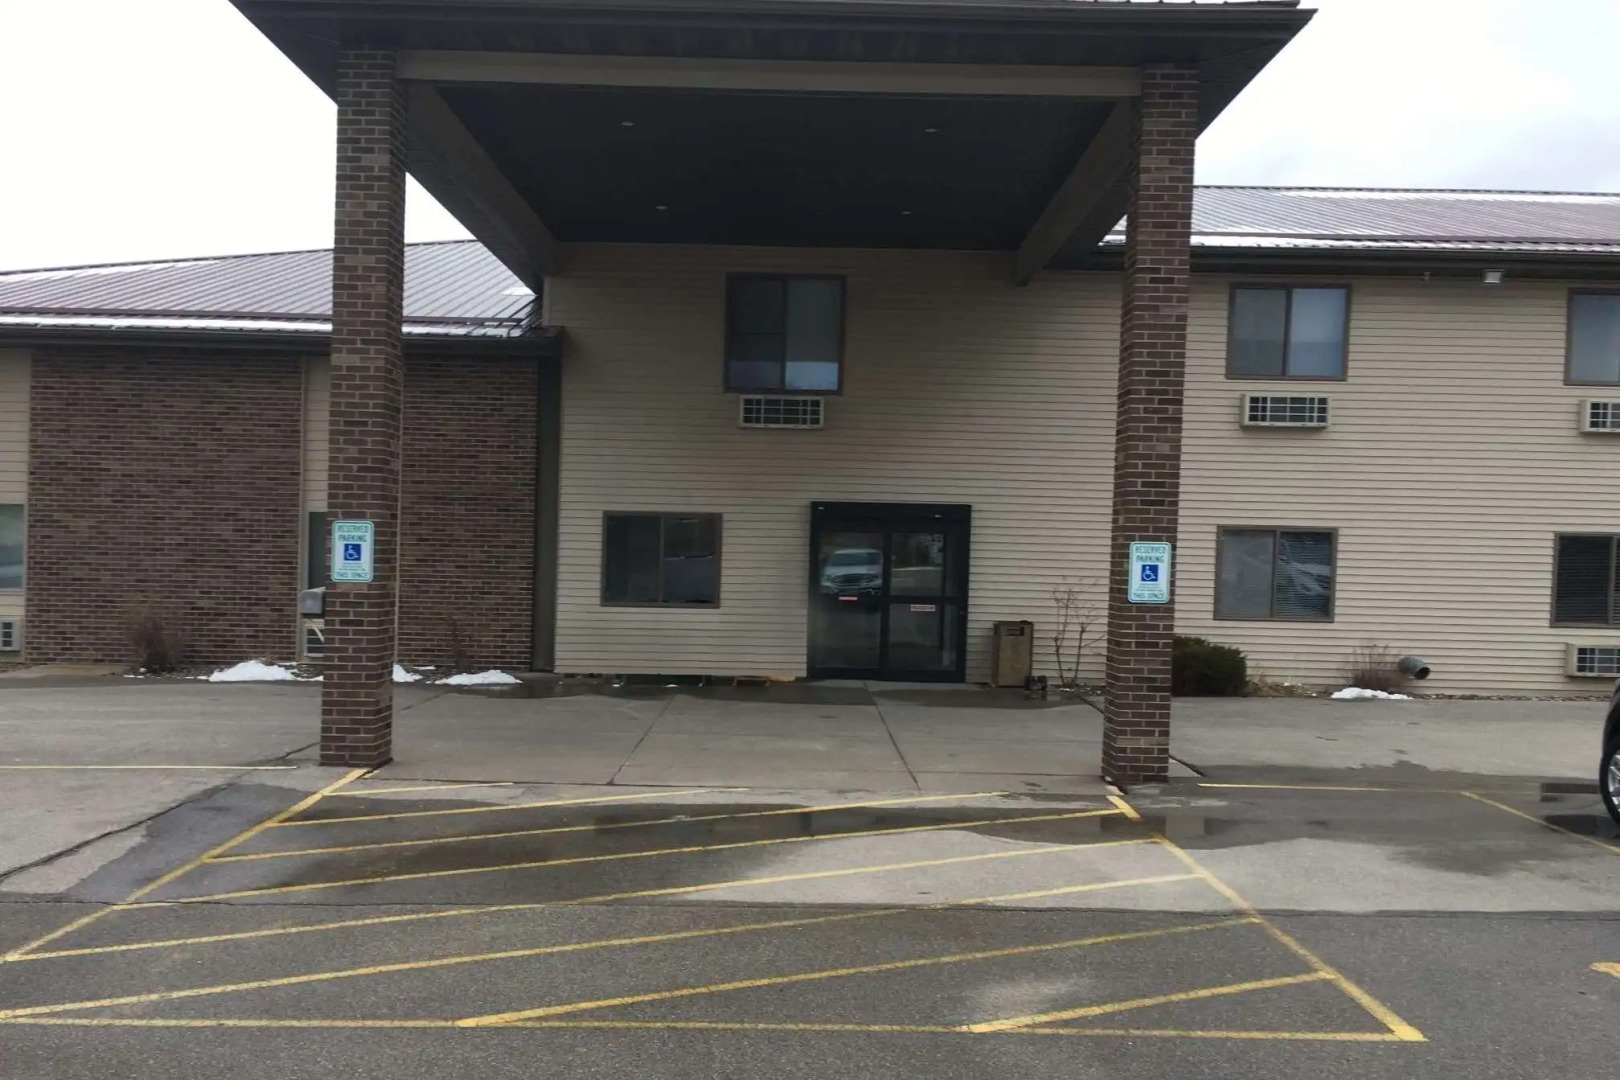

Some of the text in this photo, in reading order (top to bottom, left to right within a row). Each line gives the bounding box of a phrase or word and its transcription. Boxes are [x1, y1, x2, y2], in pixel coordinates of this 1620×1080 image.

[337, 525, 368, 533] RESERVED
[338, 534, 367, 542] PARKING
[1135, 546, 1166, 554] RESERVED
[1135, 555, 1165, 563] PARKING
